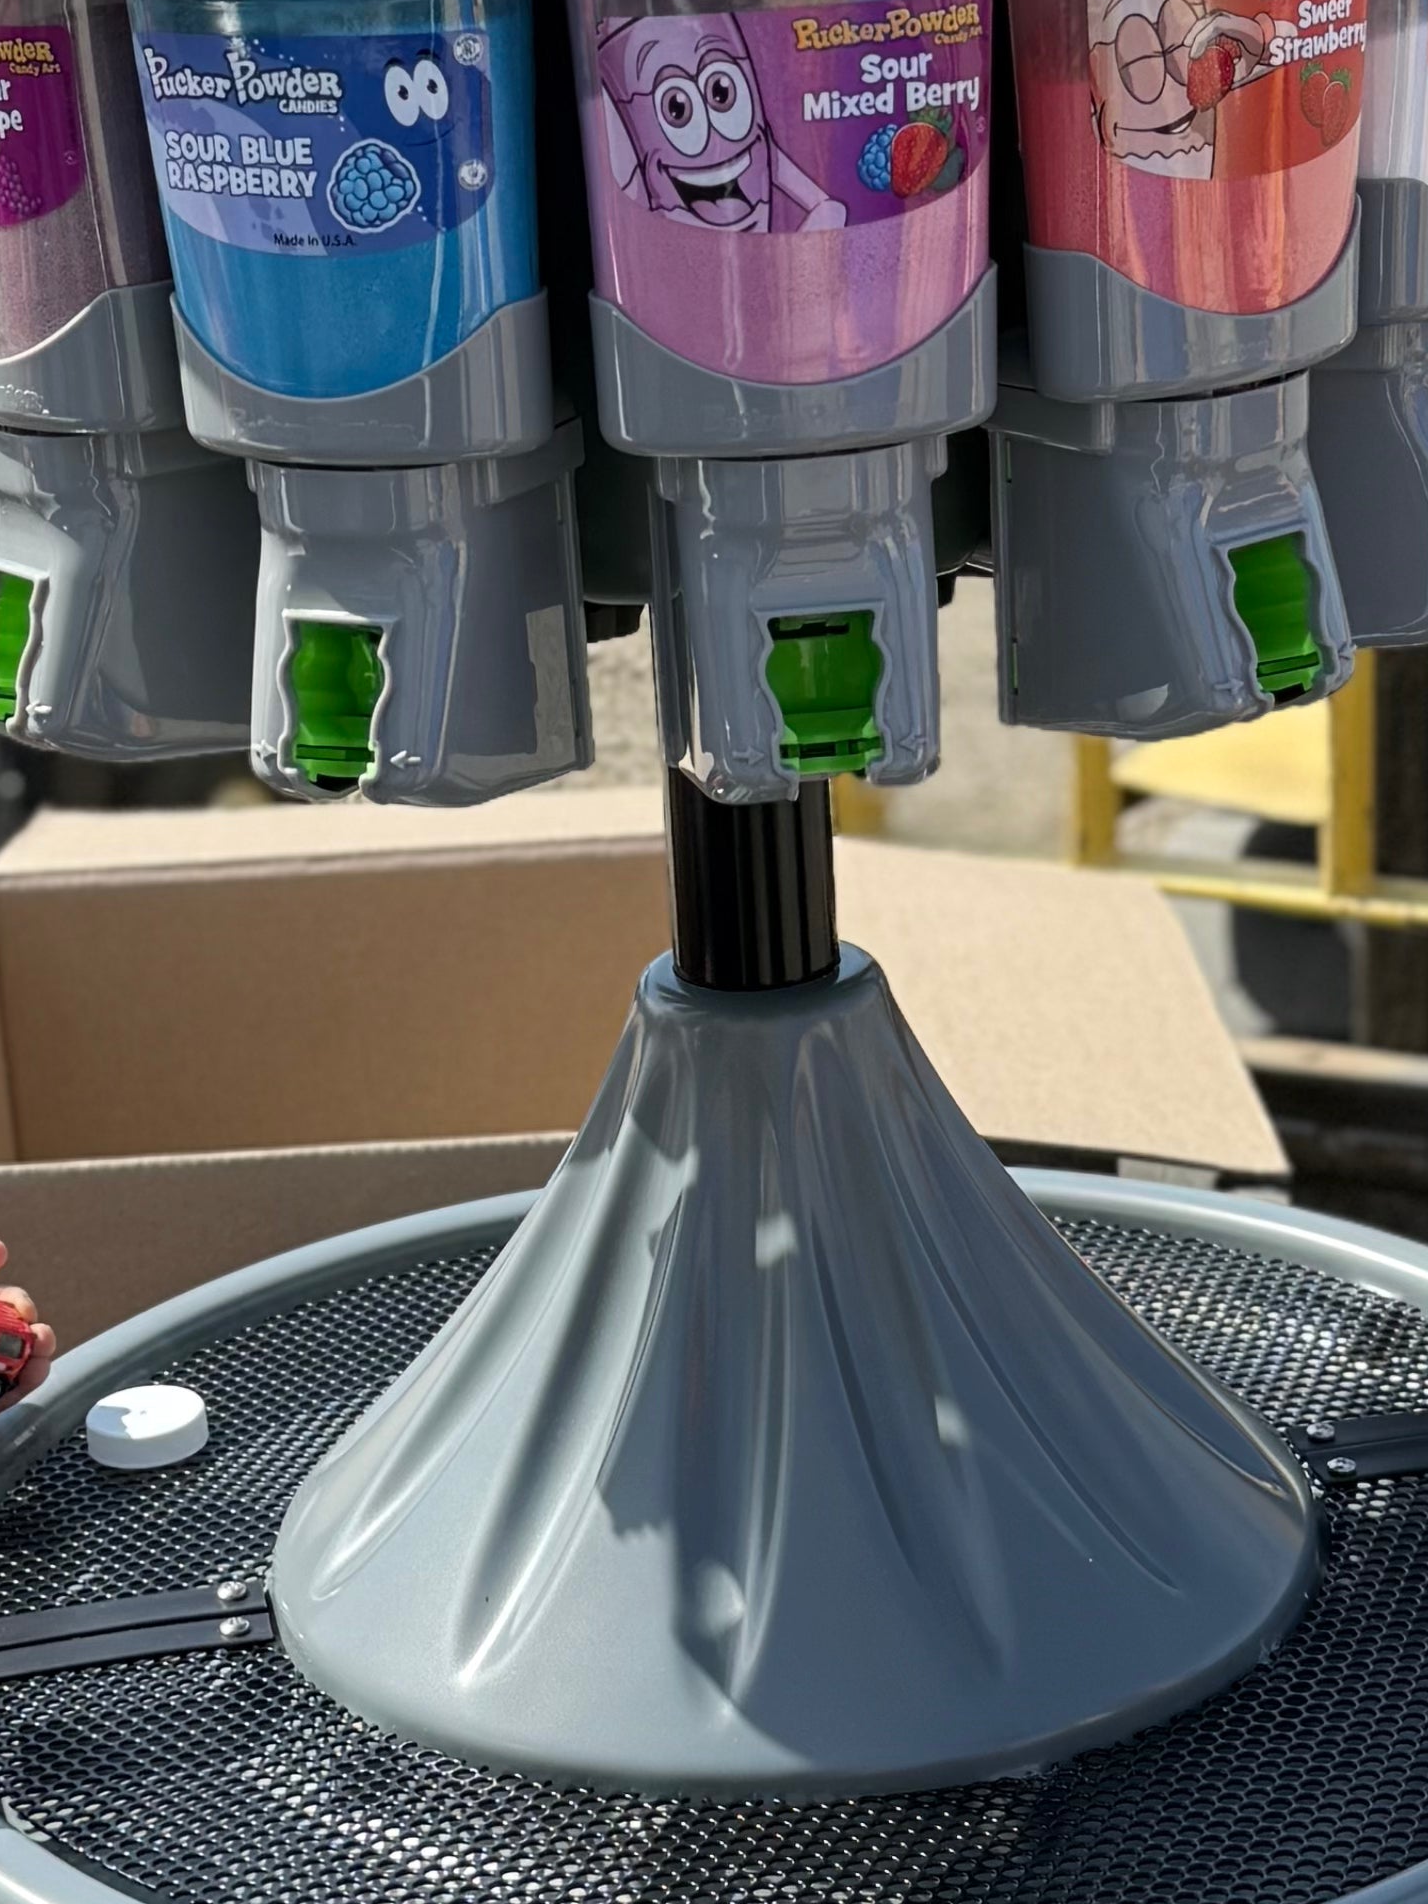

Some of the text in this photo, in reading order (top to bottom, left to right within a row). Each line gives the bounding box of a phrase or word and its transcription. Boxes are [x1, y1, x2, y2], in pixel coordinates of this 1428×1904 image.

[1269, 19, 1368, 67] Strawberry
[143, 46, 231, 100] Pucker
[860, 52, 933, 84] Sour
[278, 98, 339, 114] CANDIES
[803, 76, 981, 122] Mixed Berry
[165, 130, 314, 166] SOUR BLUE
[166, 159, 319, 198] RASPBERRY
[272, 233, 306, 247] Made
